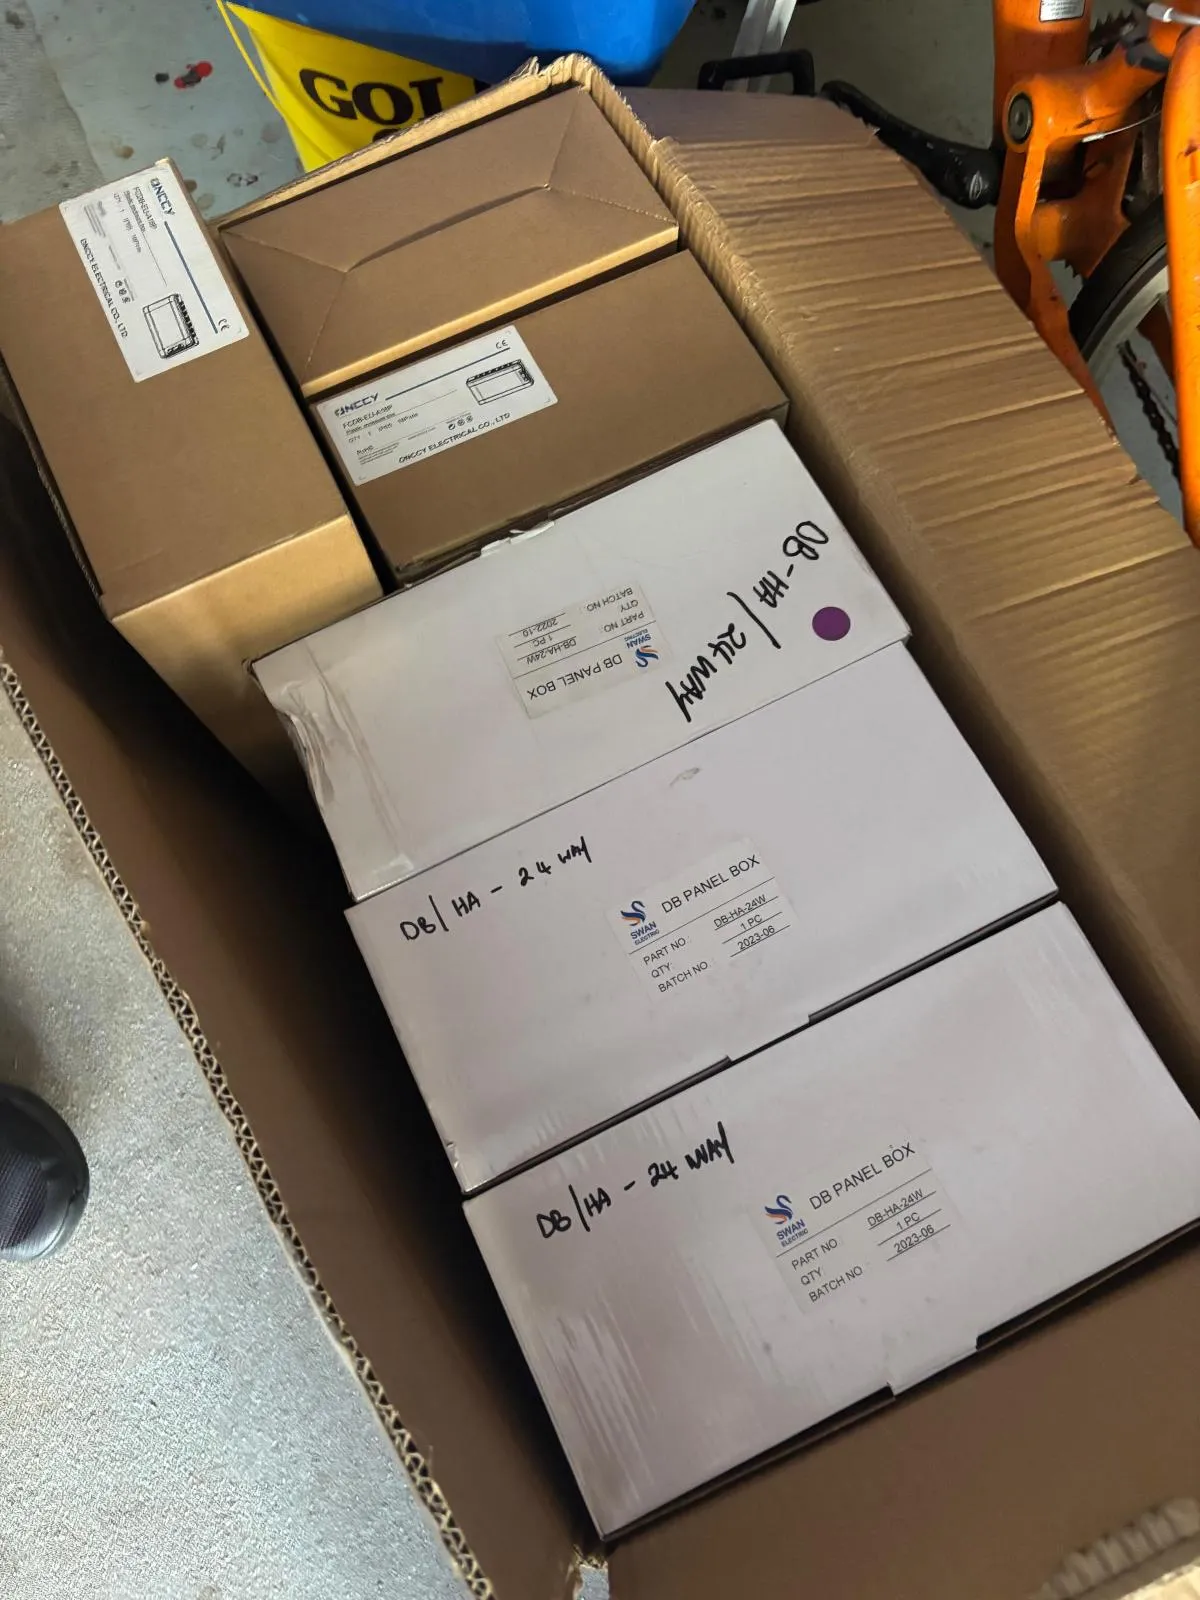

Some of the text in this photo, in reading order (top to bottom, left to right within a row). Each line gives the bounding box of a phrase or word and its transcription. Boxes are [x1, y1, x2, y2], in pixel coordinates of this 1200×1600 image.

[428, 428, 477, 451] ELECTRICAL
[603, 587, 634, 606] BATCH
[620, 599, 639, 613] QTY
[522, 617, 559, 638] 2022-10
[621, 611, 645, 627] PART
[526, 638, 577, 665] DB-HA-24W
[532, 638, 547, 647] PC
[626, 633, 652, 649] SWAN
[526, 653, 623, 701] DB PANEL BOX
[661, 854, 760, 914] DB PANEL BOX
[630, 921, 657, 940] SWAN
[634, 929, 660, 946] ELECTRIC
[643, 945, 669, 966] PART
[713, 894, 766, 929] DB-HA-24W
[651, 962, 672, 979] QTY
[747, 914, 763, 927] PC
[658, 969, 692, 993] BATCH
[737, 925, 776, 951] 2023-06
[808, 1141, 916, 1210] DB PANEL BOX
[776, 1219, 806, 1241] SWAN
[781, 1229, 809, 1248] ELECTRIC
[791, 1247, 820, 1270] PART
[867, 1188, 924, 1228] DB-HA-24W
[800, 1266, 822, 1286] QTY
[903, 1212, 922, 1228] PC
[808, 1275, 845, 1303] BATCH
[893, 1223, 935, 1253] 2023-06
